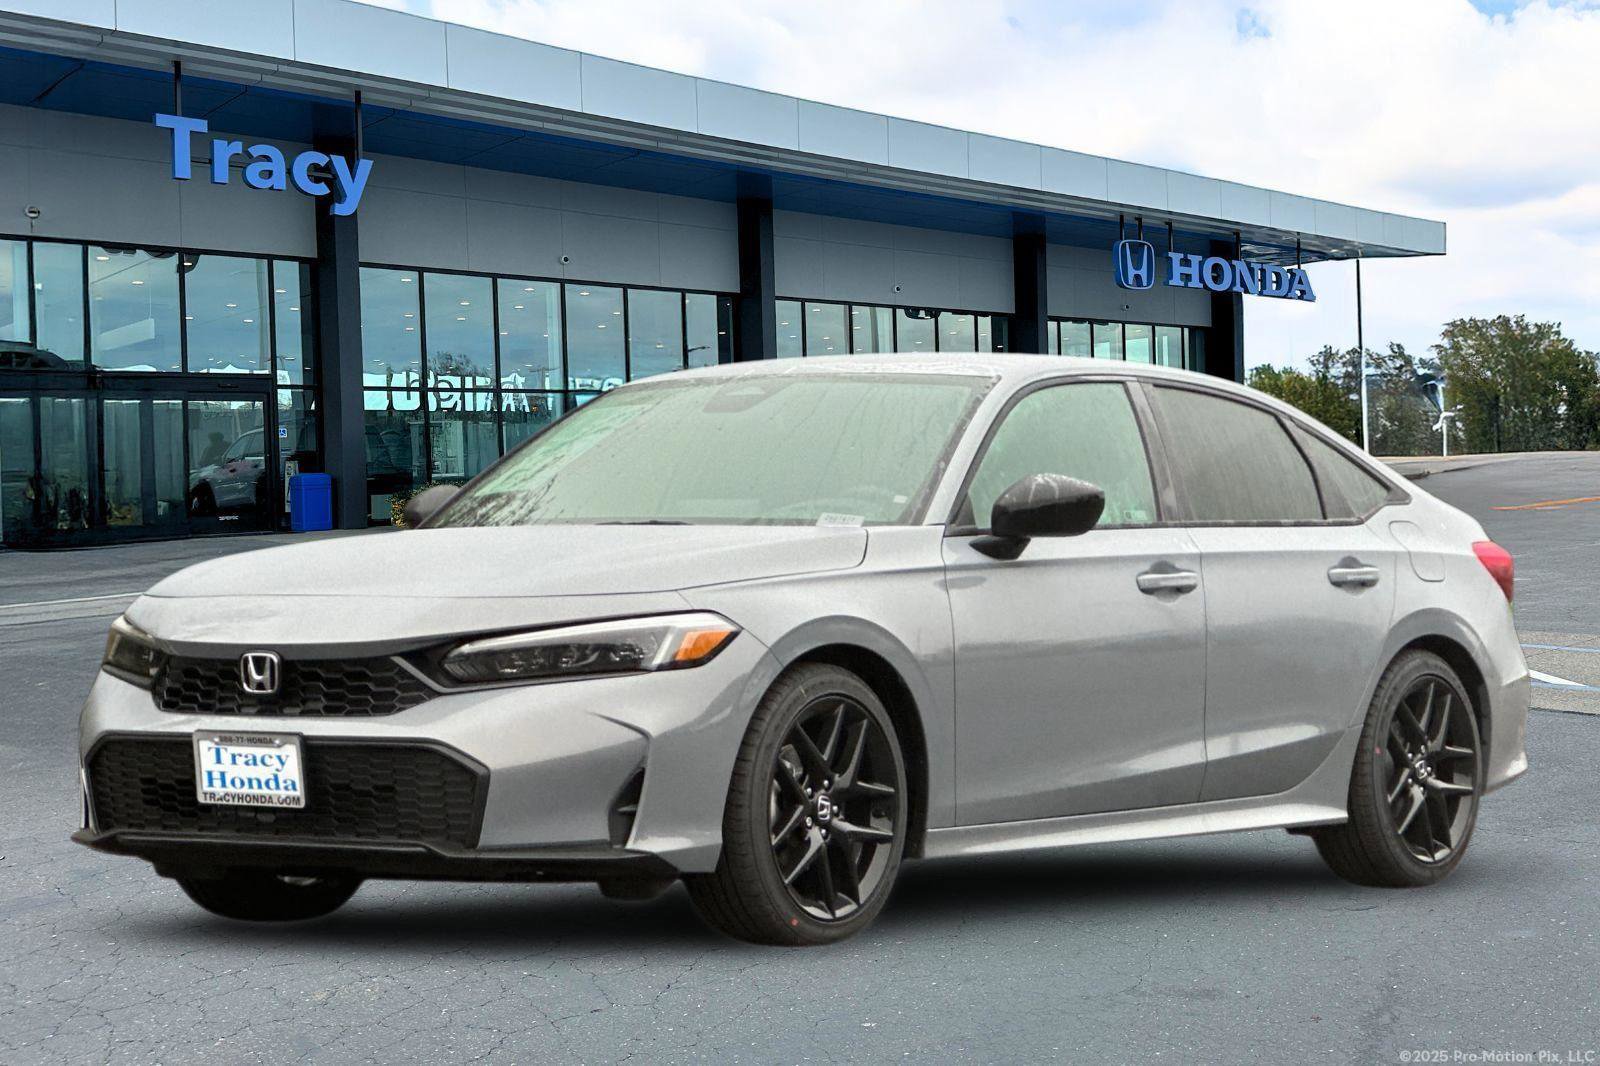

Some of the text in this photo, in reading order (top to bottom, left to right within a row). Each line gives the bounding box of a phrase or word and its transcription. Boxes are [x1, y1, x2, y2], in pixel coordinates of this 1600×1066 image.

[153, 113, 374, 216] Tracy
[1167, 251, 1316, 302] HONDA
[207, 745, 290, 772] Tracy
[205, 770, 298, 792] Honda
